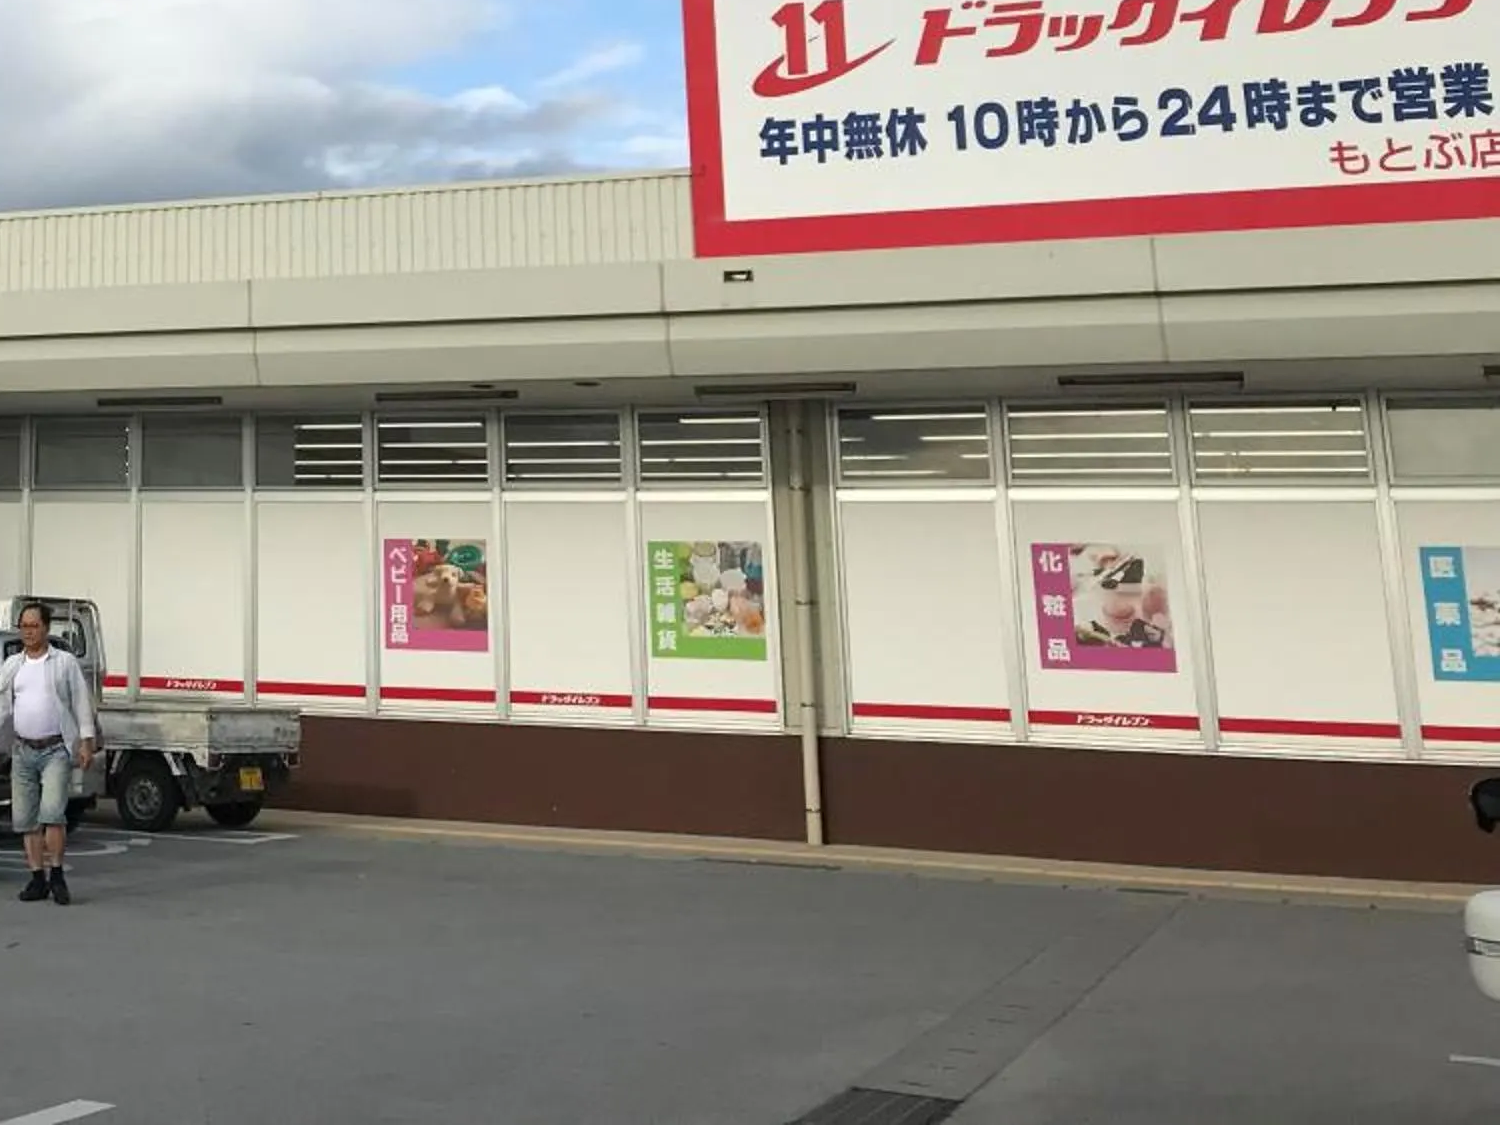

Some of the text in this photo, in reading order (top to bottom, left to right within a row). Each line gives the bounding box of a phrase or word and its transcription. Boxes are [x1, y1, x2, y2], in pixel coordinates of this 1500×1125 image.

[758, 61, 1494, 166] 年中無休 10時から24時まで営業
[388, 546, 410, 644] ベビー用品
[1038, 549, 1072, 663] 化粧品
